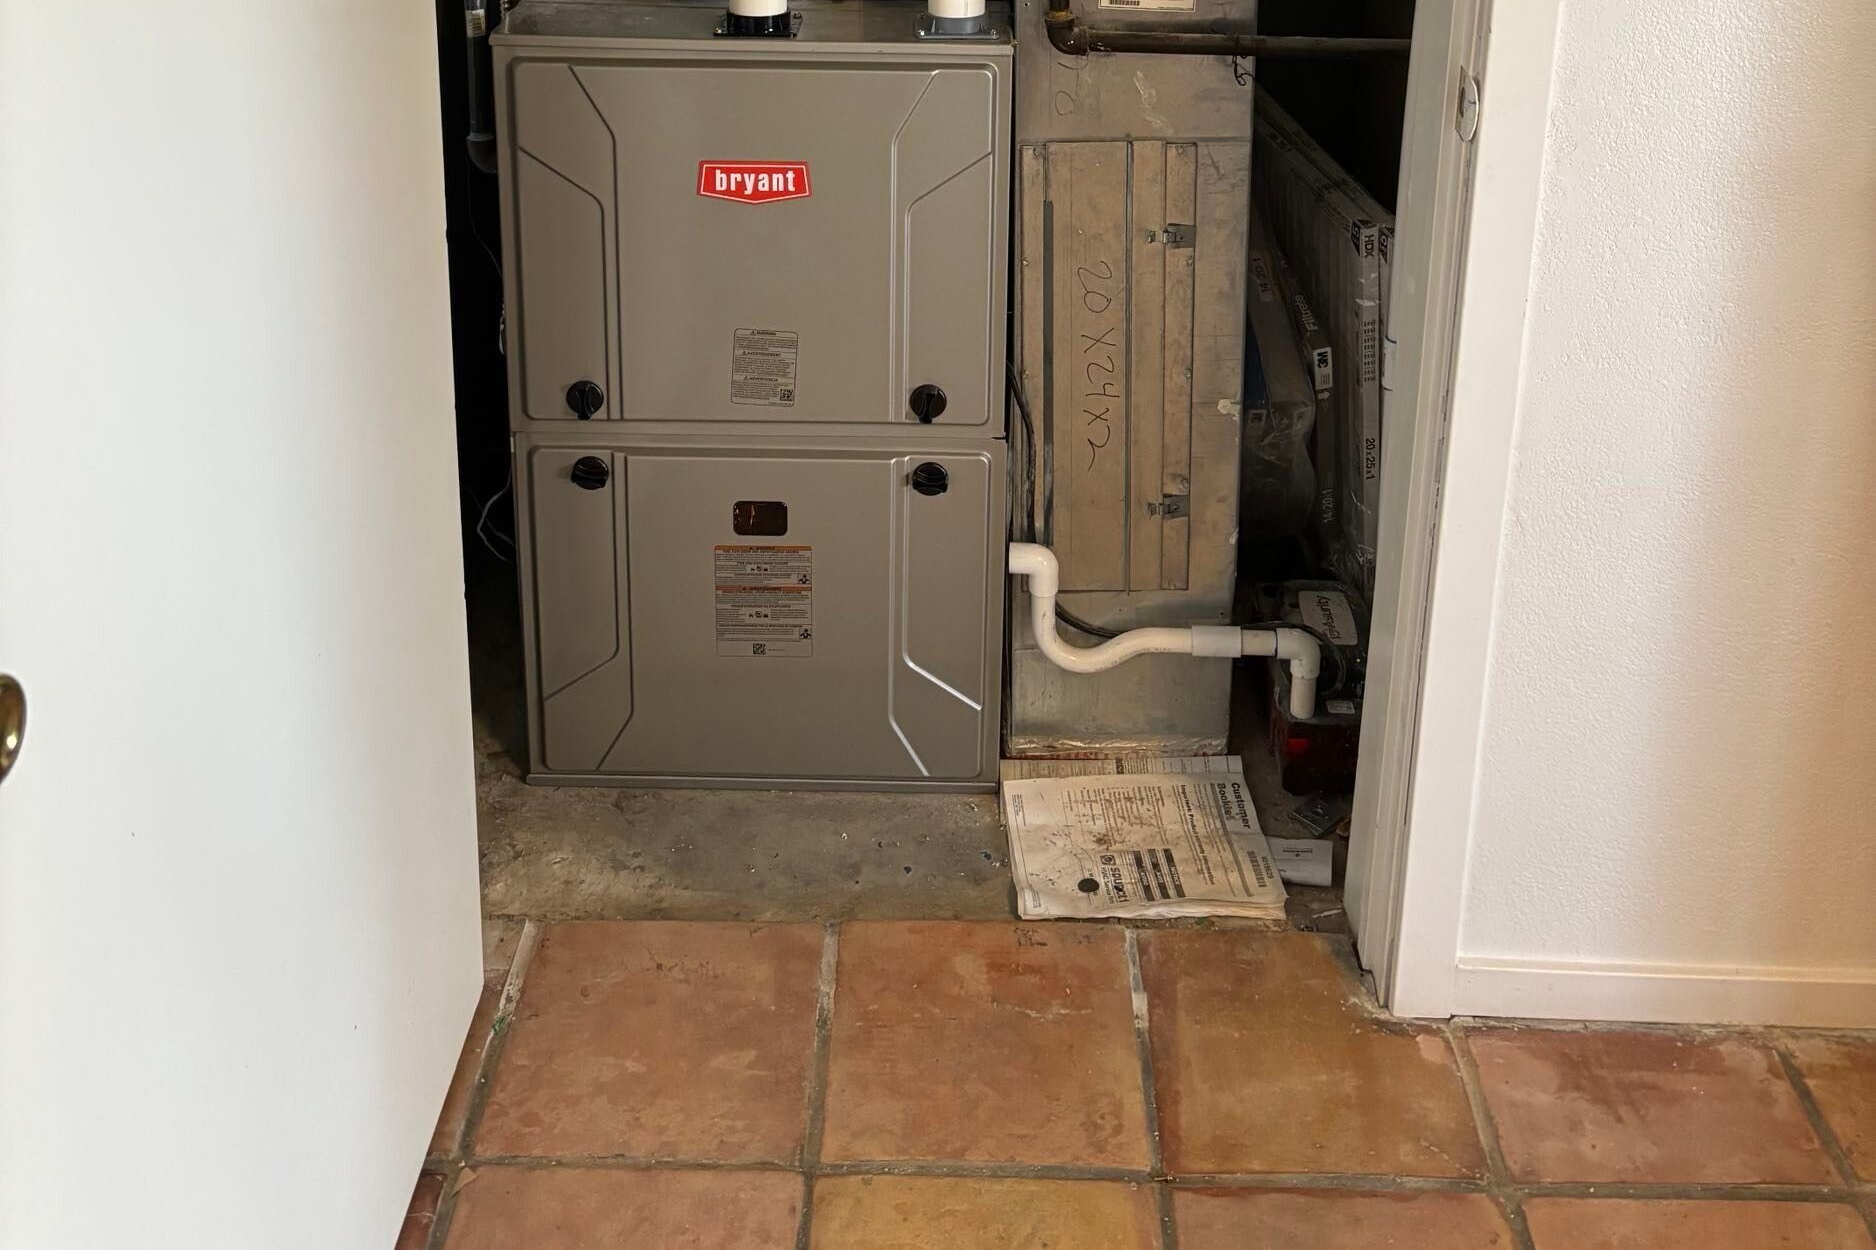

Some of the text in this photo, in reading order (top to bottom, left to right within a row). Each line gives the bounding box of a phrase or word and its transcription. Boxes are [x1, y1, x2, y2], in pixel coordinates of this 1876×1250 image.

[715, 168, 796, 195] bryant
[1364, 234, 1374, 259] HDX
[1317, 350, 1328, 369] 3M
[1365, 437, 1376, 481] 20x25x1
[1230, 782, 1252, 830] Customer
[1188, 813, 1200, 836] Product
